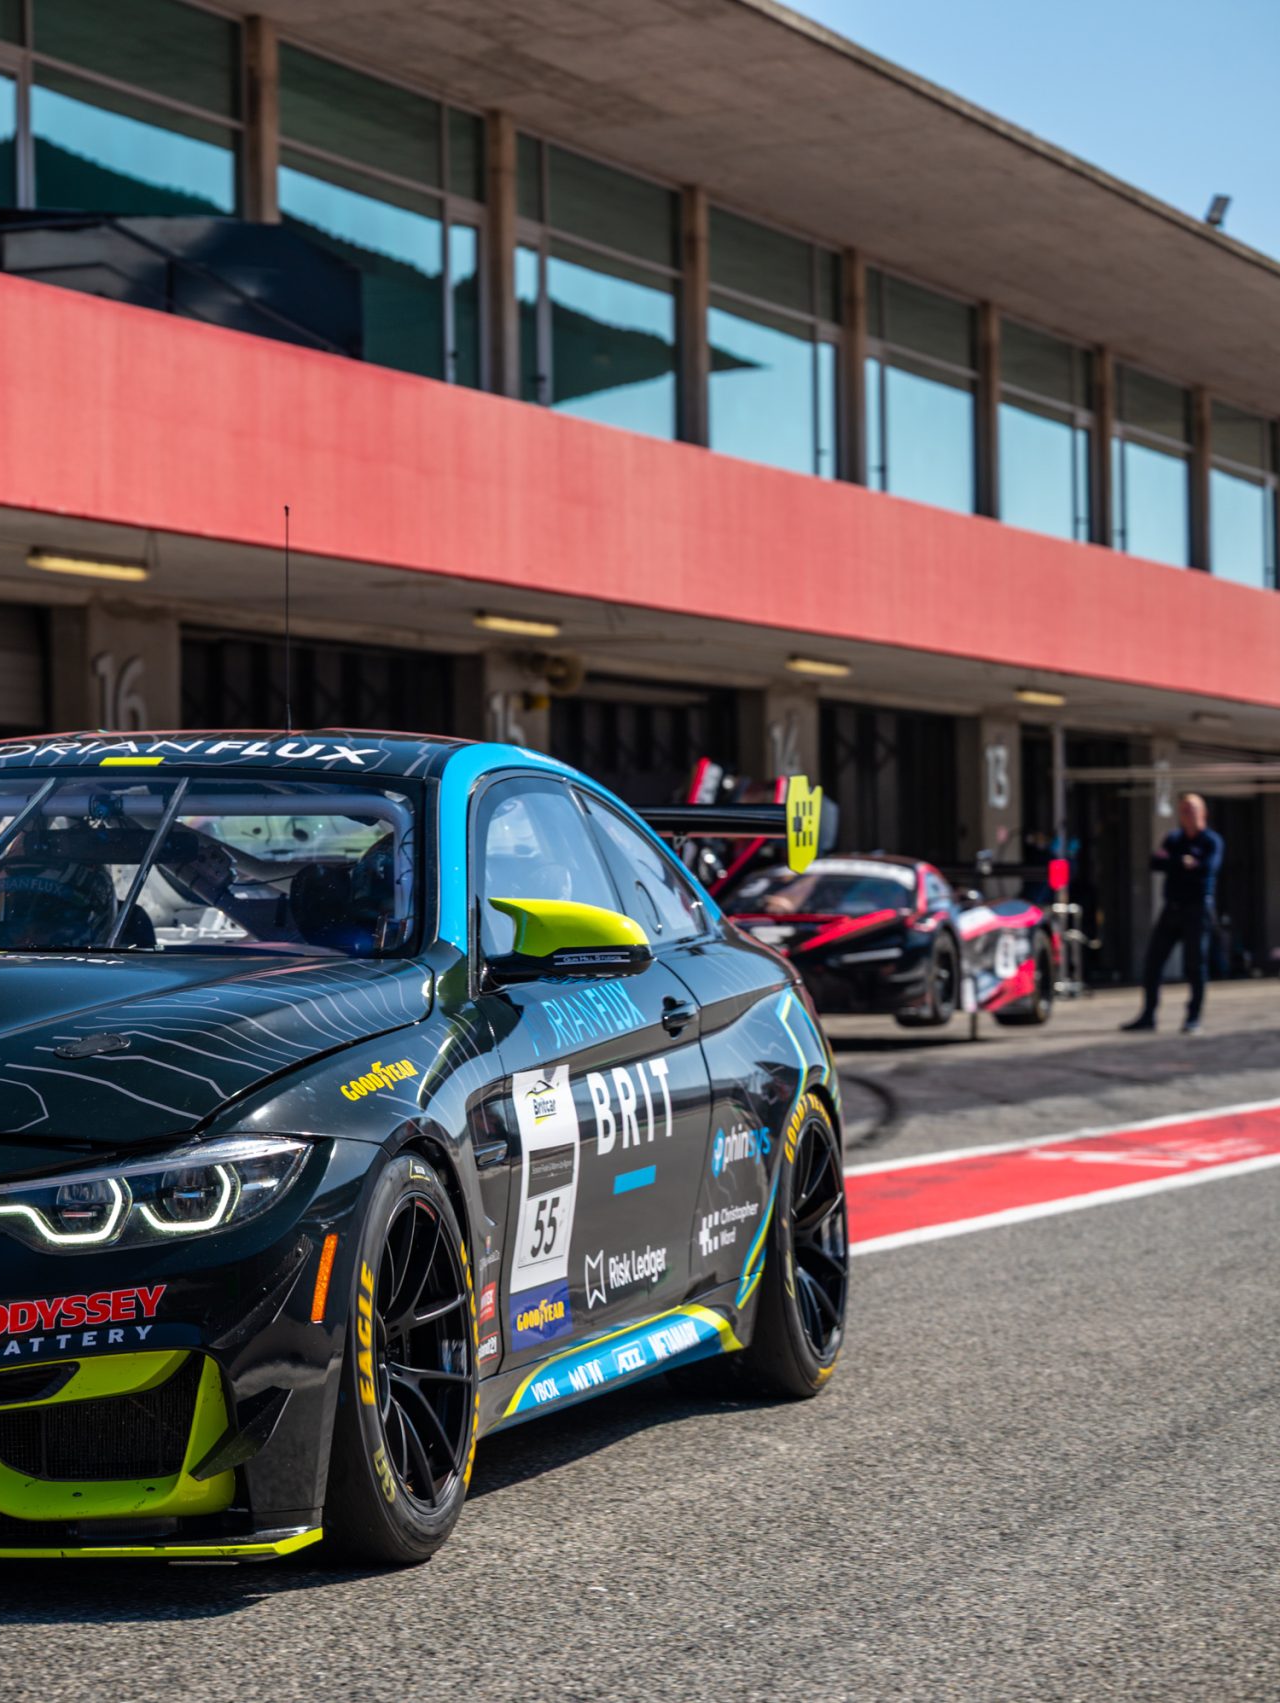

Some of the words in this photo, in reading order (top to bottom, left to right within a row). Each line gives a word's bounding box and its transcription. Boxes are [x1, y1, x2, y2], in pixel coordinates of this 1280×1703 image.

[96, 655, 147, 731] 16
[340, 1059, 419, 1101] GOODYEAR
[586, 1058, 672, 1155] BRIT
[722, 1123, 771, 1172] phinsys
[530, 1196, 560, 1258] 55
[608, 1253, 632, 1290] Risk
[631, 1245, 668, 1284] Ledger
[358, 1260, 376, 1406] EAGLE
[516, 1299, 565, 1331] GOODYEAR
[531, 1377, 560, 1402] VBOX
